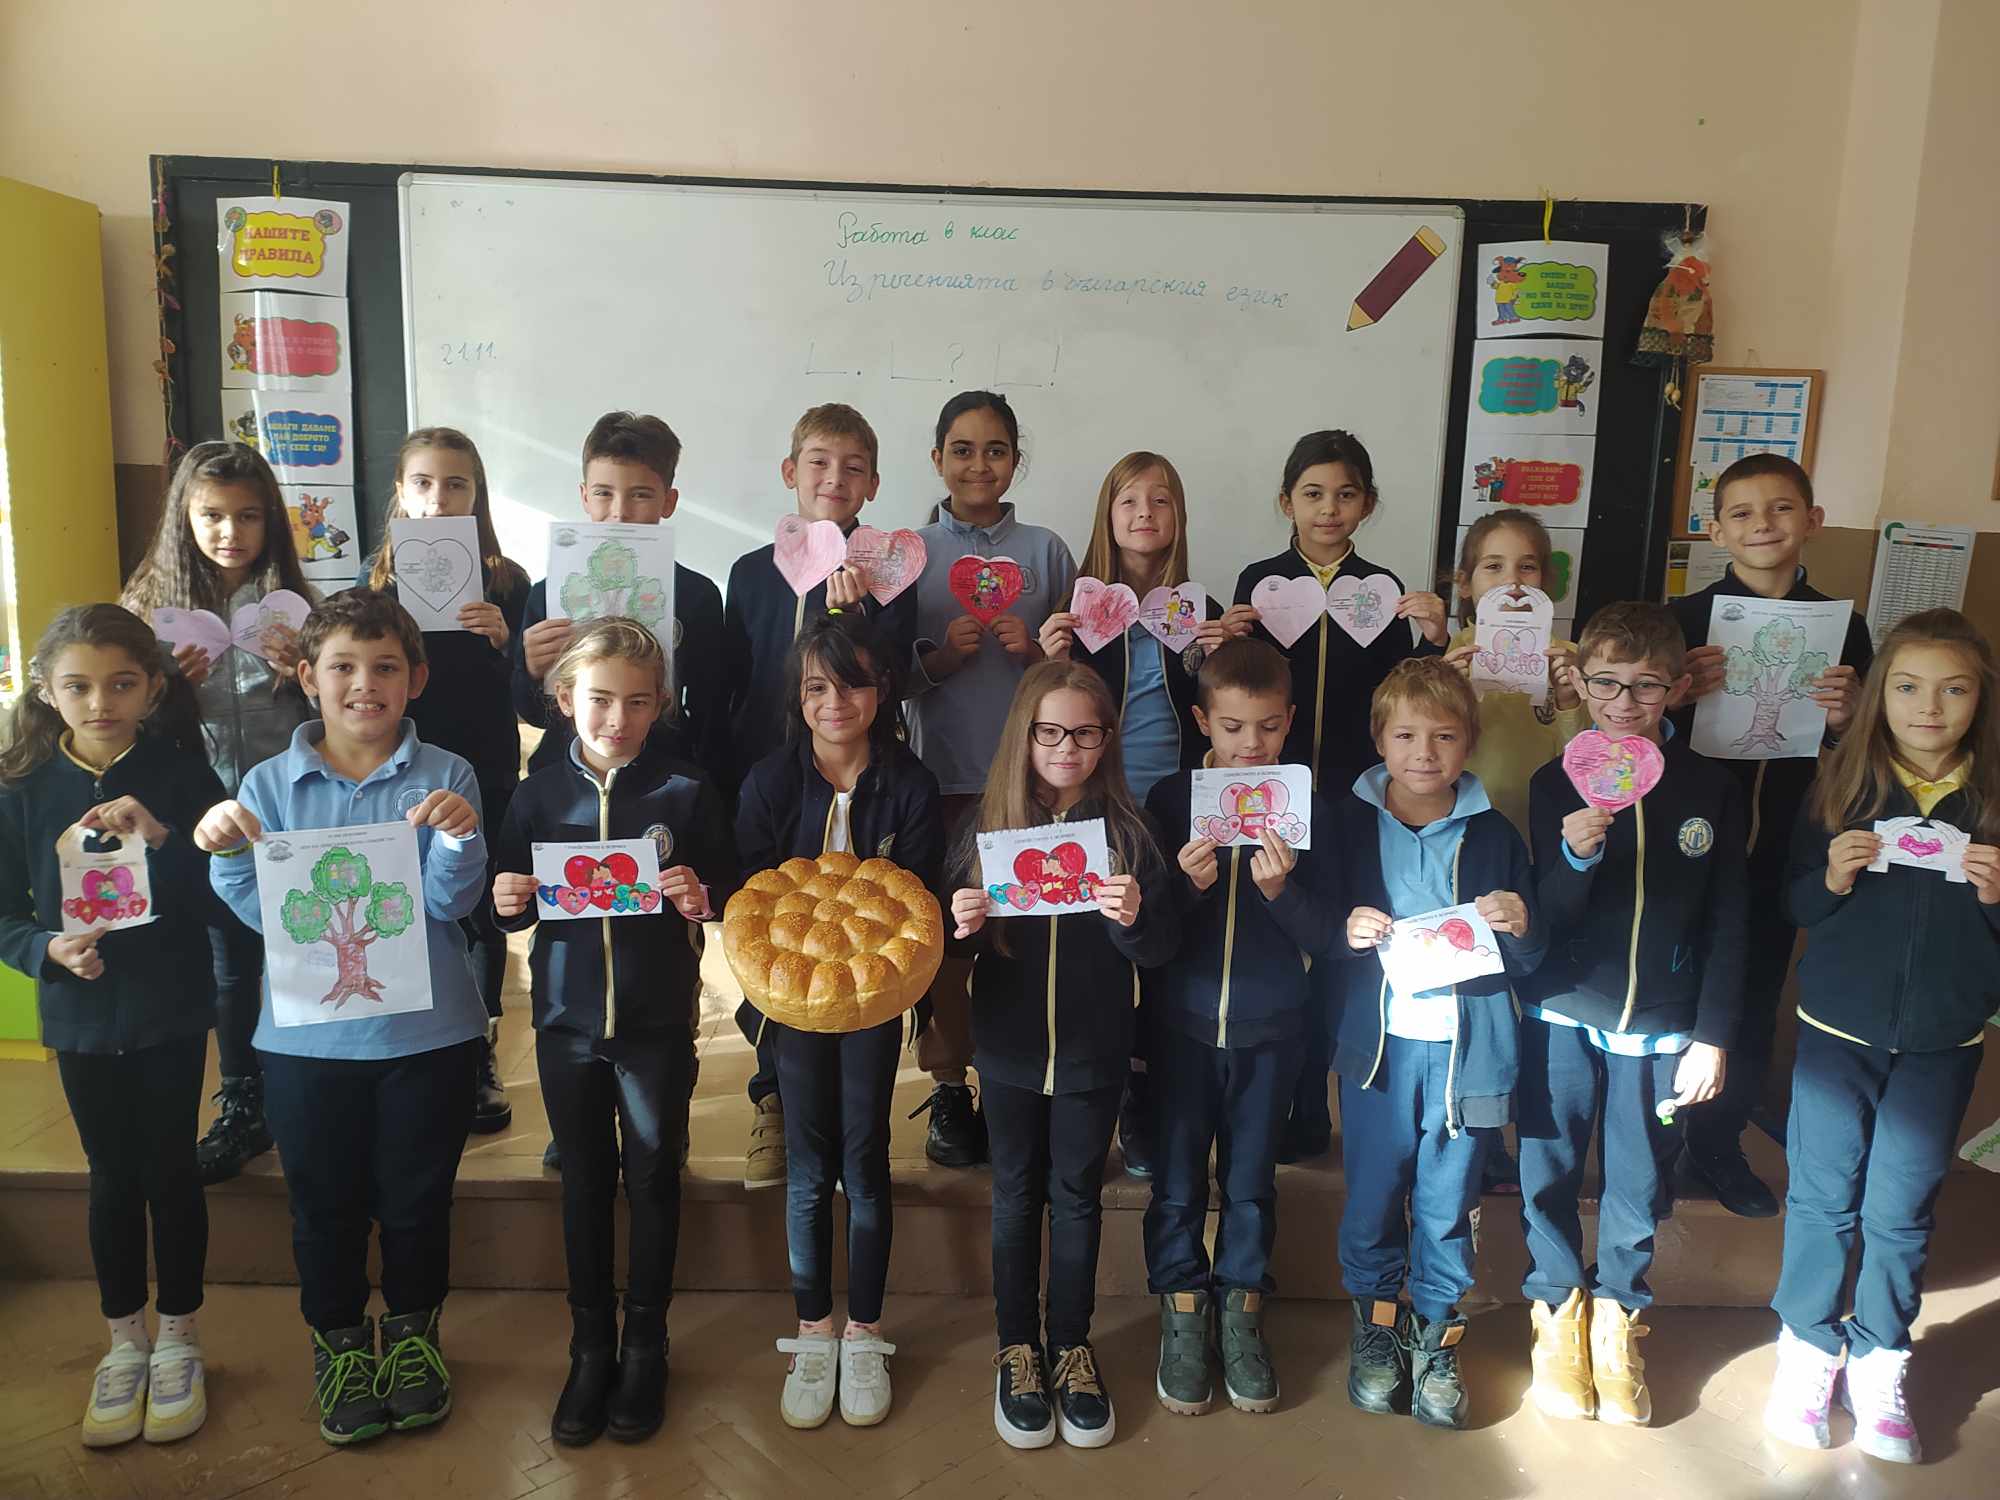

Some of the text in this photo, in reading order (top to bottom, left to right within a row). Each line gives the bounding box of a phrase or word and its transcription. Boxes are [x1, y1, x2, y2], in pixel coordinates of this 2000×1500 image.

[836, 211, 1020, 249] Работа в клас
